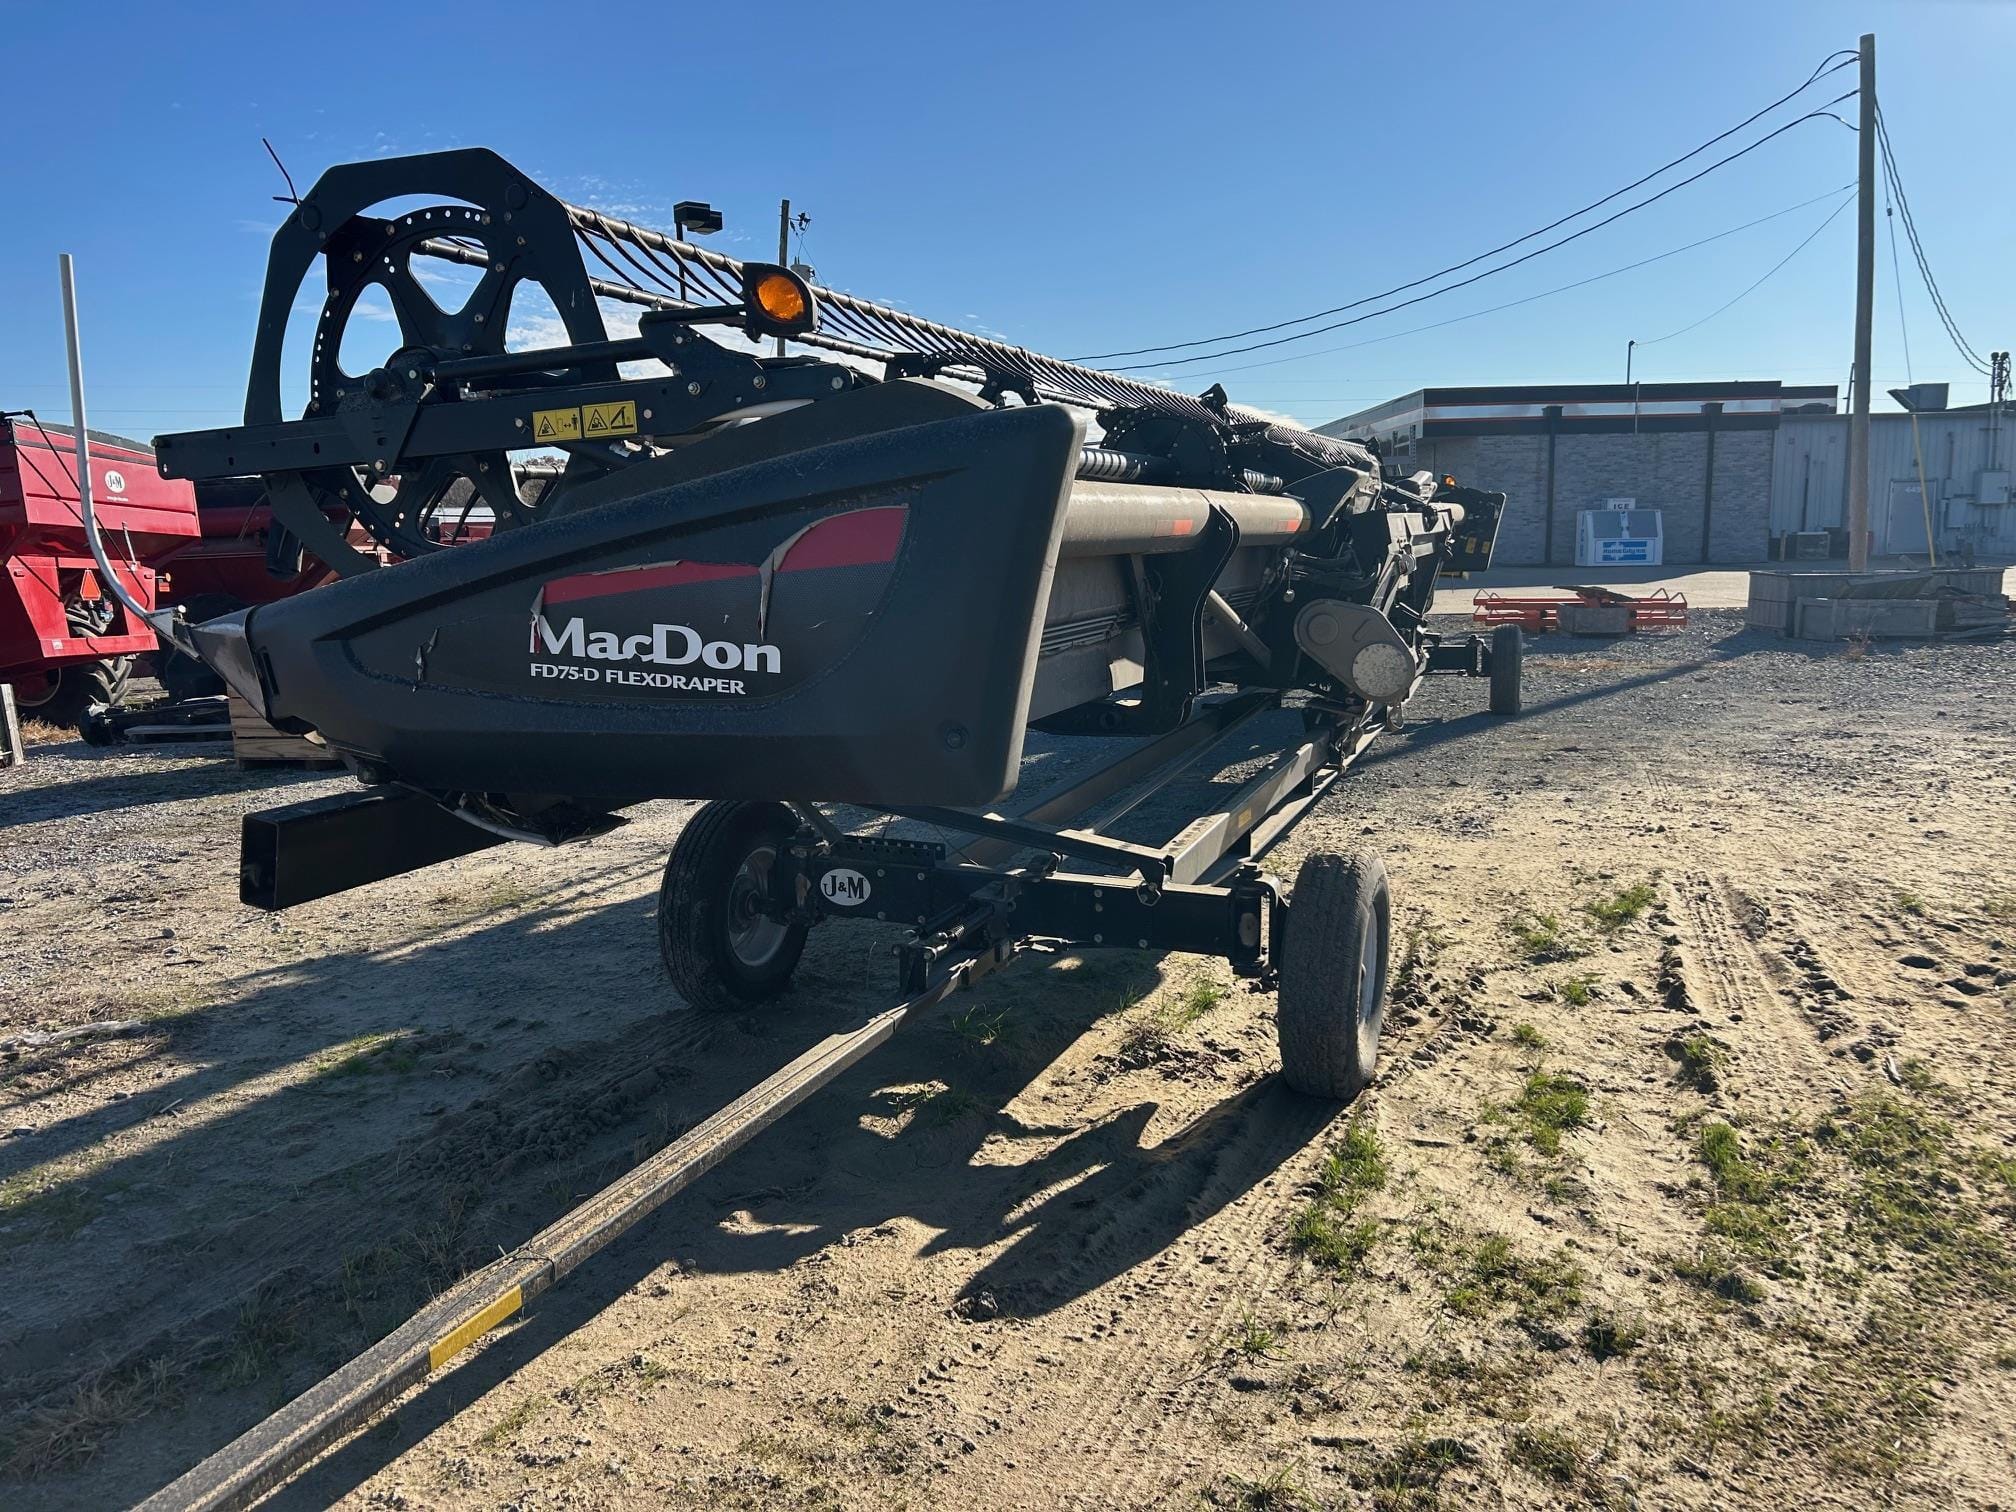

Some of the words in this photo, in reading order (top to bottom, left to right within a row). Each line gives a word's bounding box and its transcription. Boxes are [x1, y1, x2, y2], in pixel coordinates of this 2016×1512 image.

[529, 615, 781, 674] MacDon
[530, 663, 600, 682] FD75-D
[605, 669, 746, 695] FLEXDRAPER
[823, 875, 865, 899] J&M
